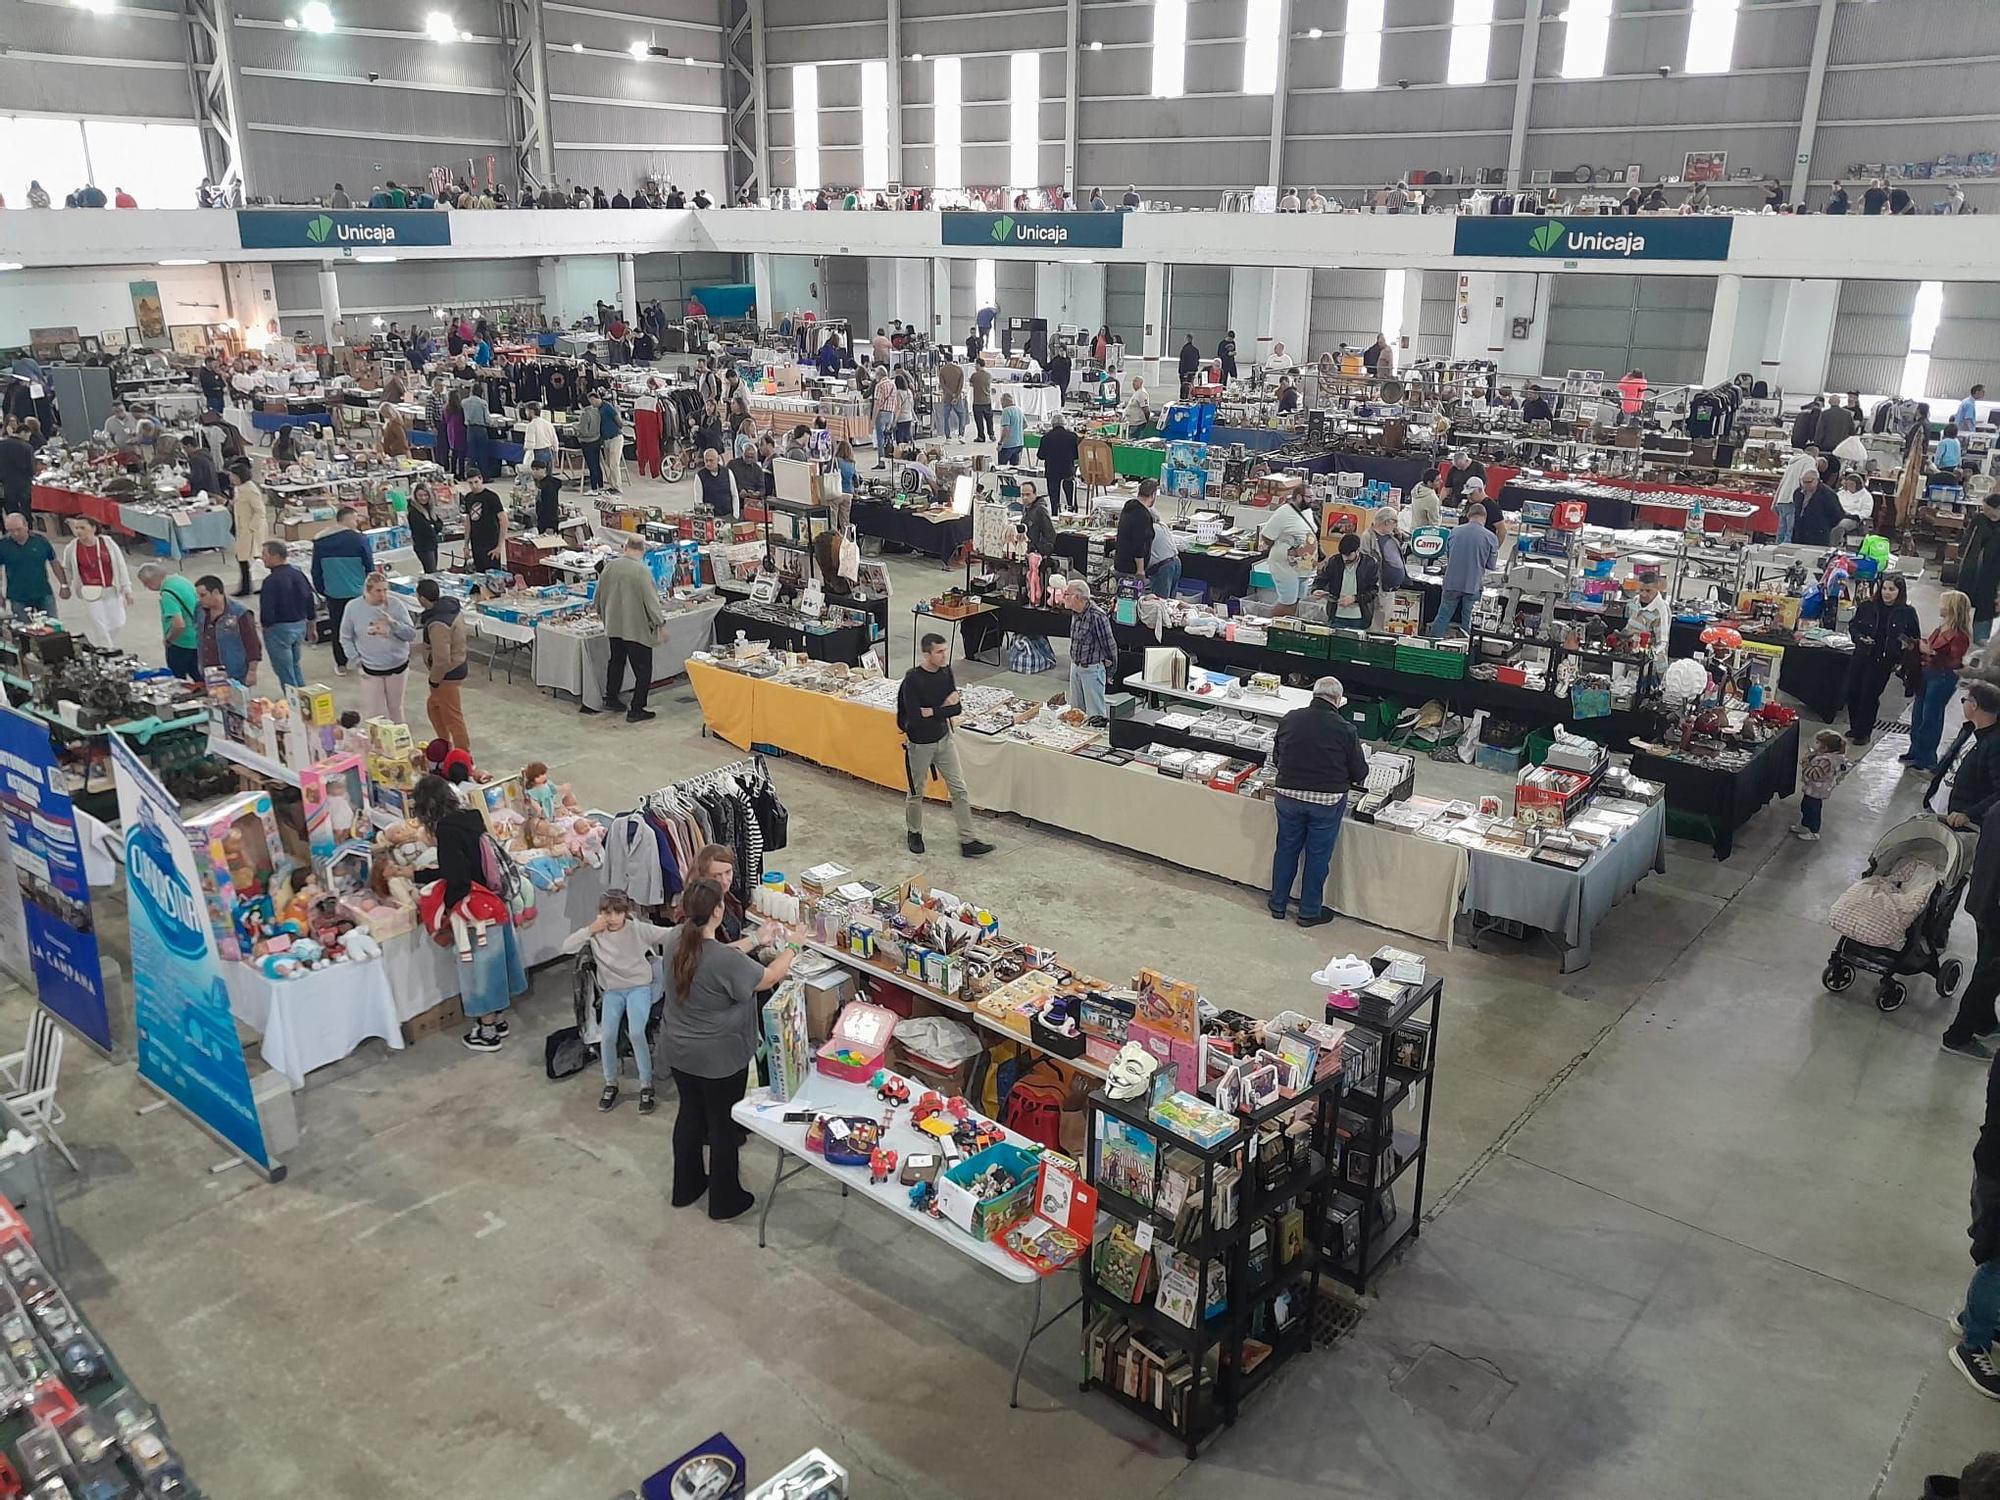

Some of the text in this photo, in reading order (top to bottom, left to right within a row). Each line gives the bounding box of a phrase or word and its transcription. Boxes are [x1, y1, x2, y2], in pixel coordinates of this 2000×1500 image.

[337, 224, 395, 244] Unicaja
[1017, 224, 1068, 245] Unicaja
[1568, 231, 1645, 256] Unicaja
[1416, 539, 1441, 551] Camy
